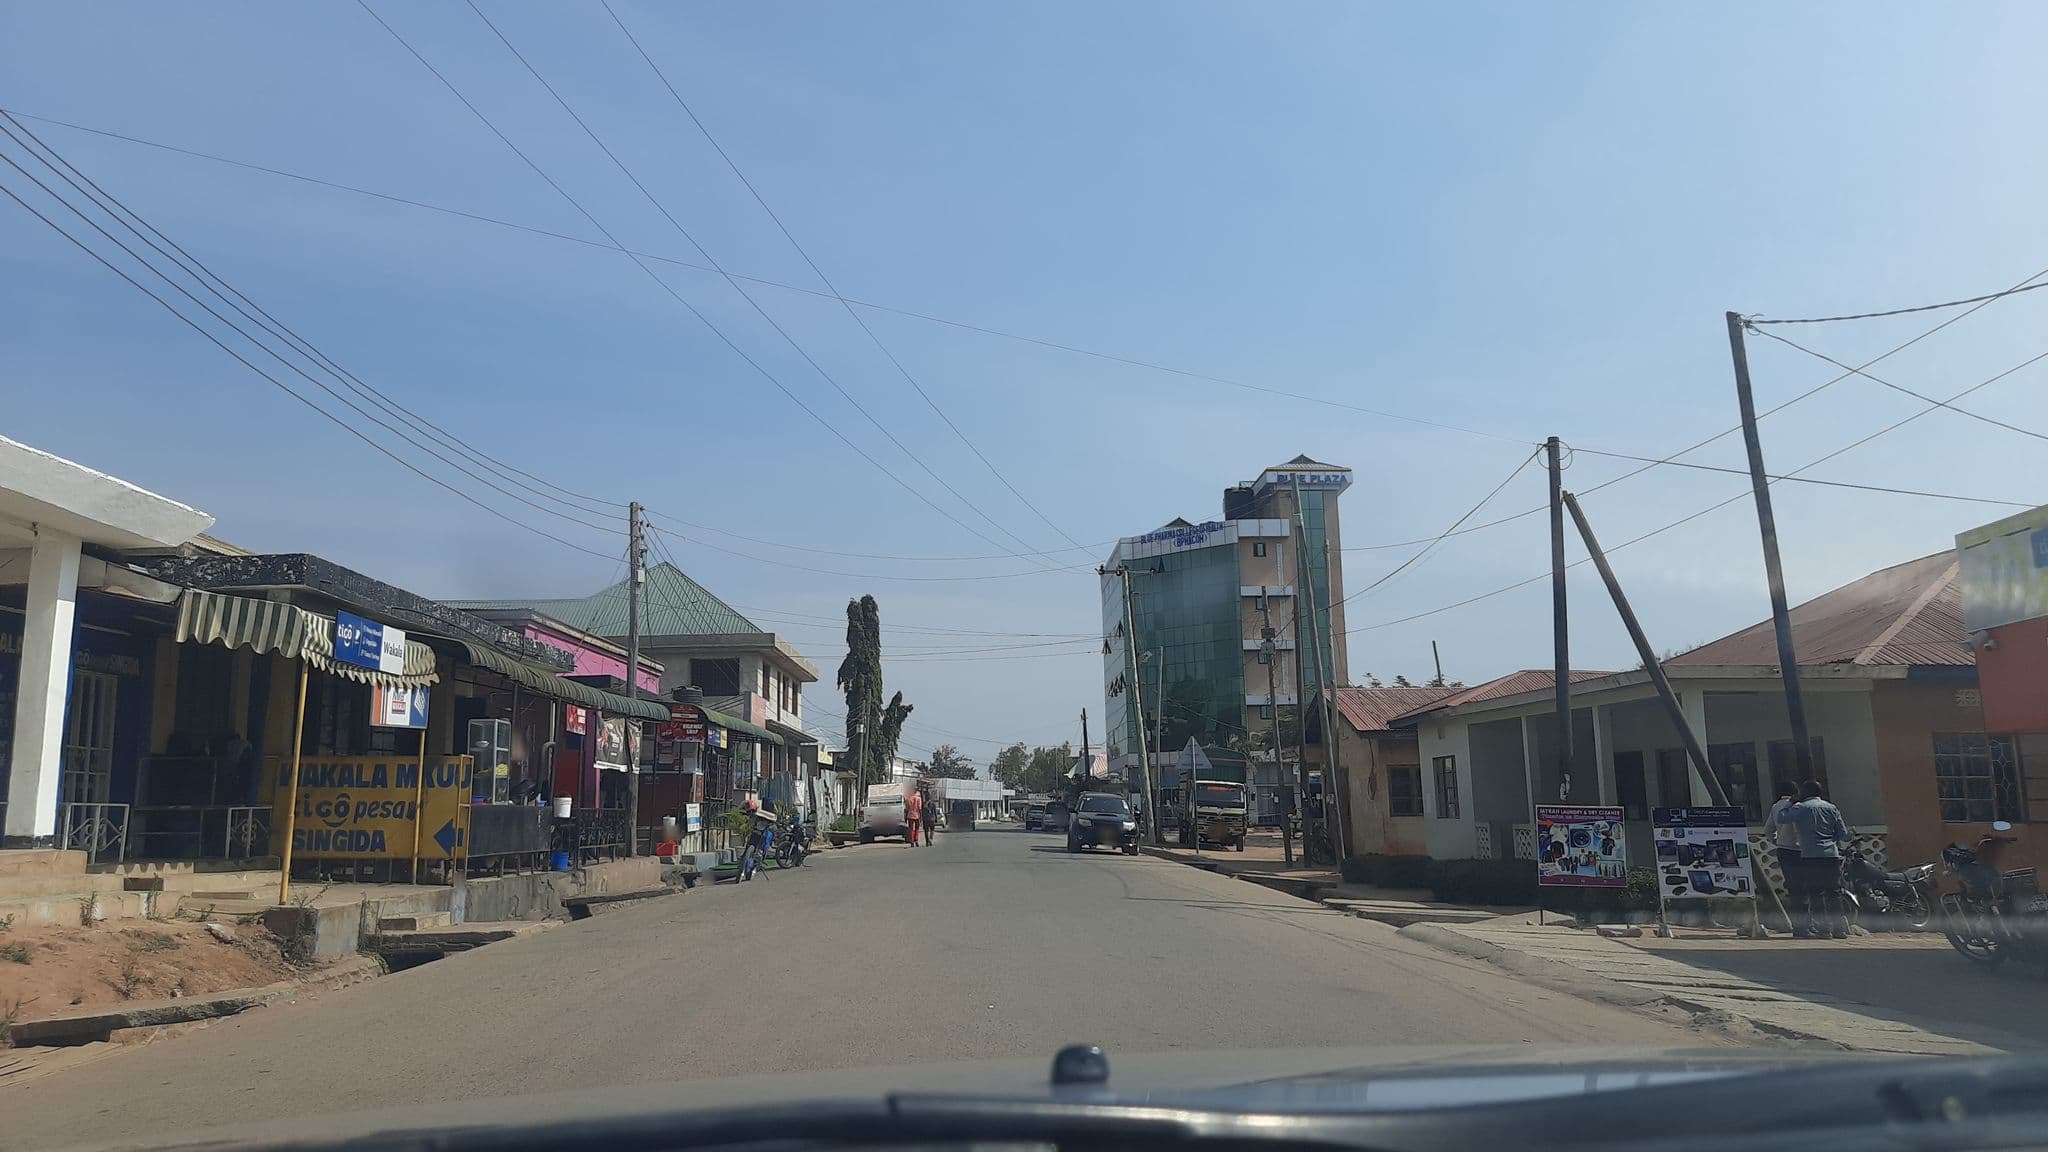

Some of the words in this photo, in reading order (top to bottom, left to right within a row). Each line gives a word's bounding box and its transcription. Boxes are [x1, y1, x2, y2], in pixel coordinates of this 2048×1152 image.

[1277, 474, 1305, 486] BLE
[1310, 474, 1347, 485] PLAZA
[384, 641, 403, 659] Wakala
[294, 829, 386, 852] SINGIDA
